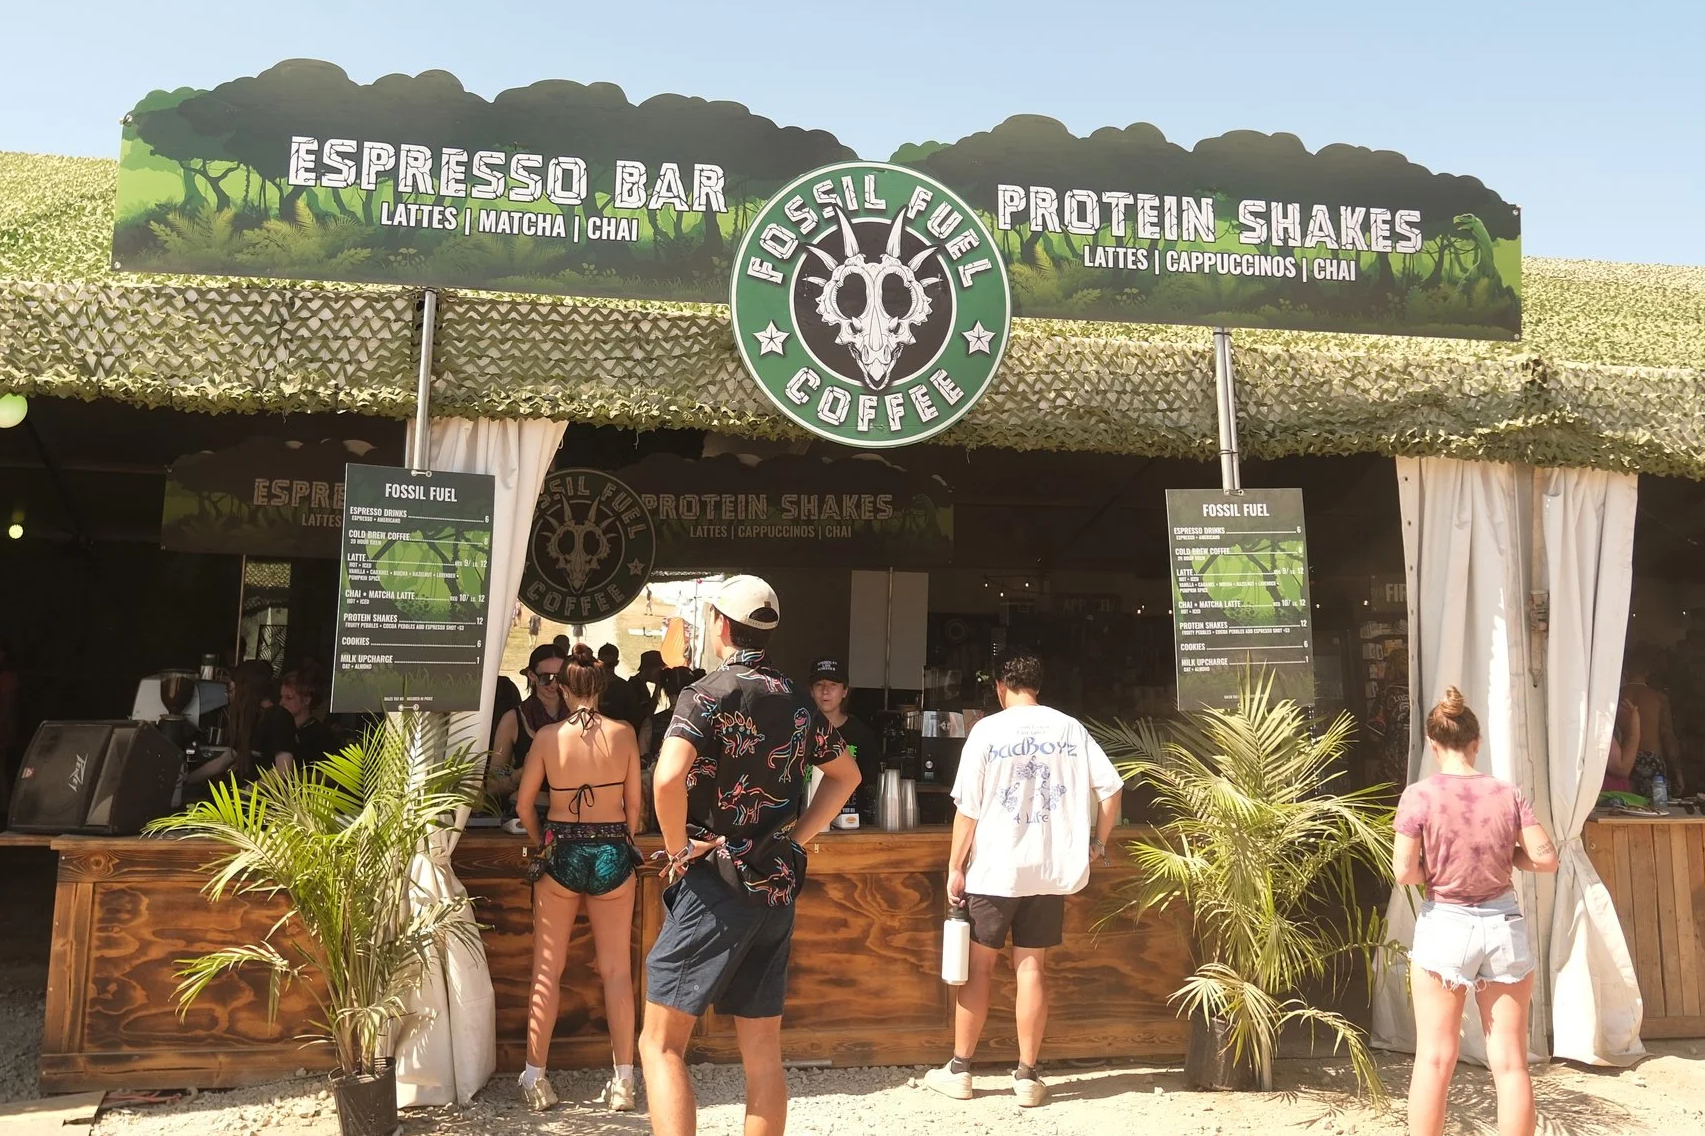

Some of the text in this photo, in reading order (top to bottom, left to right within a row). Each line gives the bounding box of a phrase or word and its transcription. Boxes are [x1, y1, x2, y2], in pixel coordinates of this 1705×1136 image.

[288, 136, 729, 214] ESPRESSO BAR
[380, 201, 639, 242] LATTES MATCHA CHAI
[996, 184, 1424, 254] PROTEIN SHAKES
[757, 174, 992, 288] FOSSIL FUEL
[1083, 245, 1356, 281] LATTES CAPPUCCINOS CHAI
[786, 366, 965, 432] COFFEE
[385, 483, 458, 502] FOSSIL FUEL
[600, 482, 647, 540] FUEL
[641, 493, 893, 520] PROTEIN SHAKES
[1202, 503, 1270, 517] FOSSIL FUEL
[302, 513, 342, 528] LATTES
[350, 506, 490, 523] ESPRESSO DRINKS 6
[348, 529, 366, 539] COLD
[367, 531, 387, 540] BREW
[387, 532, 411, 541] COFFEE
[690, 525, 852, 539] LATTES CAPPUCCINOS CHAI
[1173, 527, 1203, 535] ESPRESSO
[1296, 525, 1302, 533] 6
[1174, 548, 1191, 556] COLD
[1209, 547, 1230, 555] COFFEE
[347, 553, 367, 562] LATTE
[480, 560, 488, 568] 12
[1297, 567, 1304, 575] 12
[345, 589, 362, 598] CHAI
[368, 590, 395, 599] MATCHA
[396, 591, 415, 600] LATTE
[478, 594, 486, 603] 12
[526, 580, 627, 617] COFFEE
[1178, 601, 1193, 609] CHAI
[1198, 600, 1223, 608] MATCHA
[1224, 600, 1241, 608] LATTE
[1299, 599, 1306, 607] 12
[343, 613, 484, 625] PROTEIN SHAKES 12
[1179, 619, 1308, 630] PROTEIN SHAKES 12
[341, 637, 482, 648] COOKIES 6
[1180, 640, 1309, 651] COOKIES 6
[340, 654, 480, 664] MILK UPCHARGE 1
[1196, 658, 1228, 666] UPCHARGE
